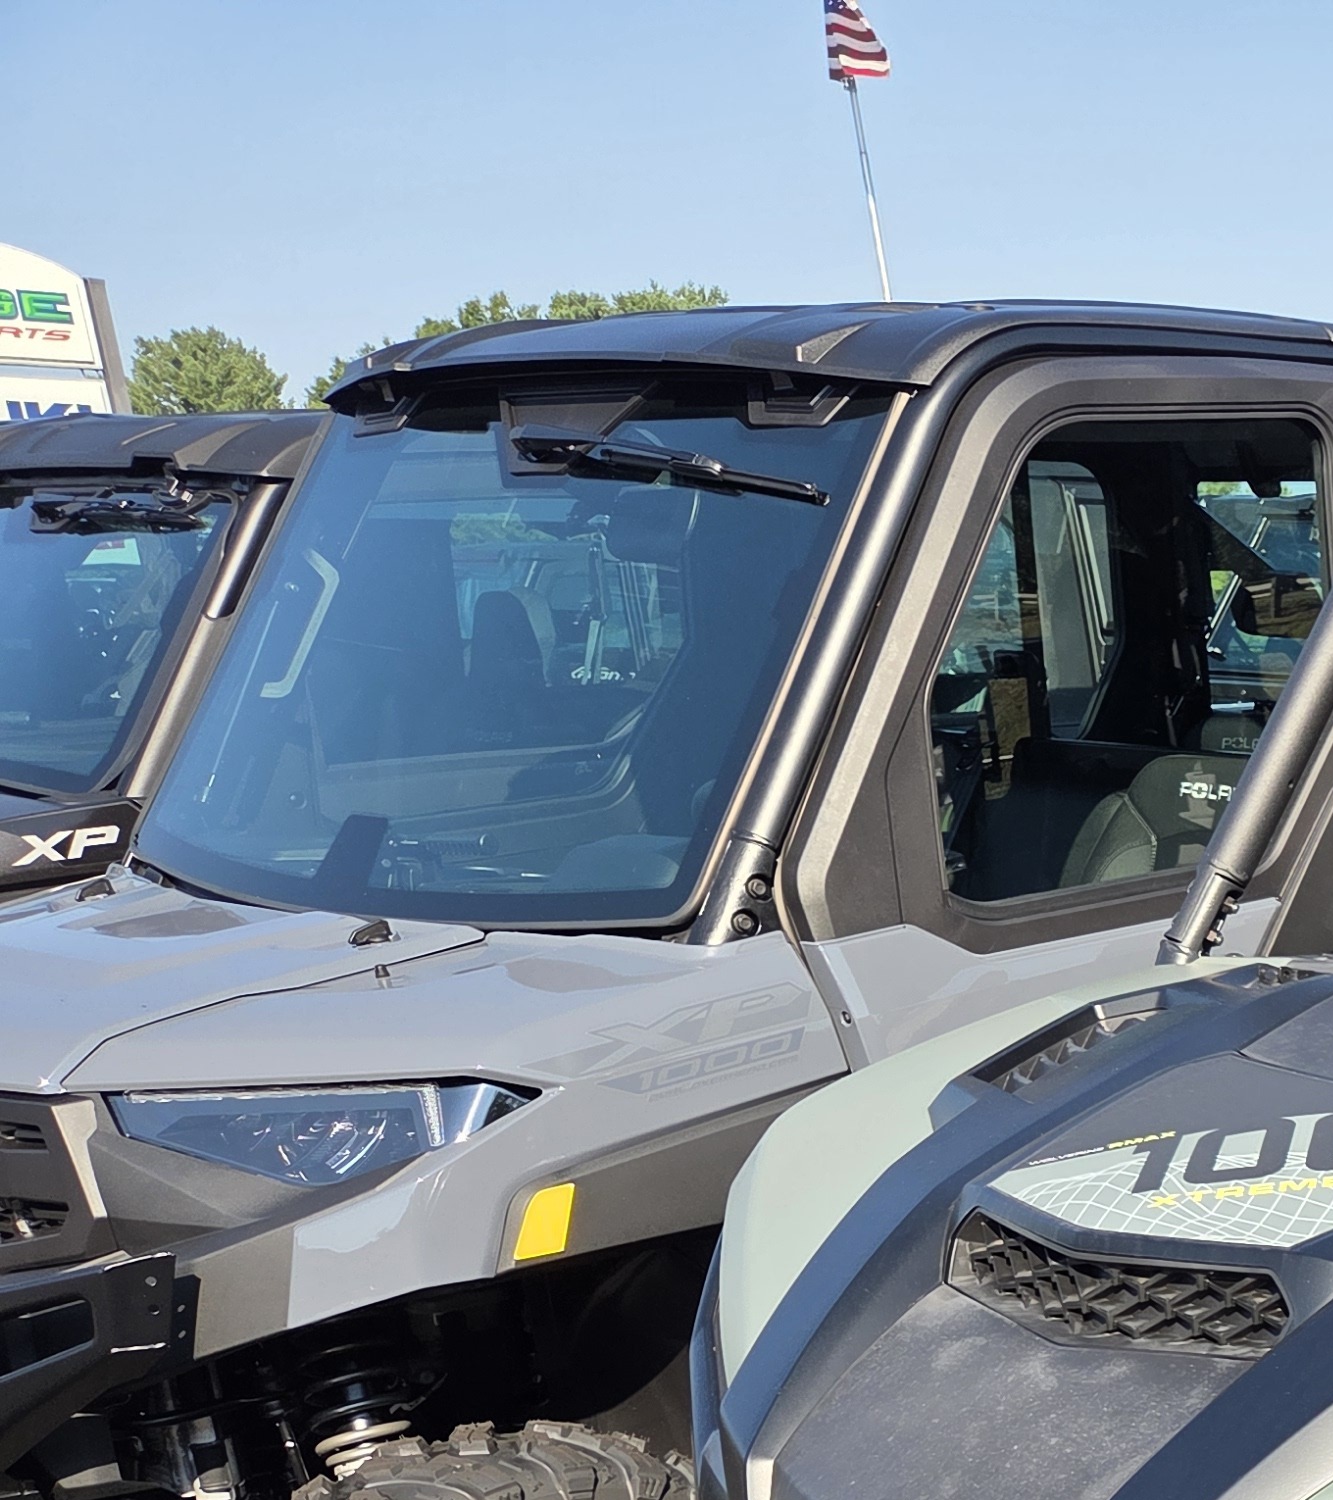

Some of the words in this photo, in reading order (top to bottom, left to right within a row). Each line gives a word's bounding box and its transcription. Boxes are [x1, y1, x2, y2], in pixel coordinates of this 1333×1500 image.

[11, 825, 121, 867] XP
[578, 981, 804, 1076] XP
[638, 1032, 794, 1093] 1000
